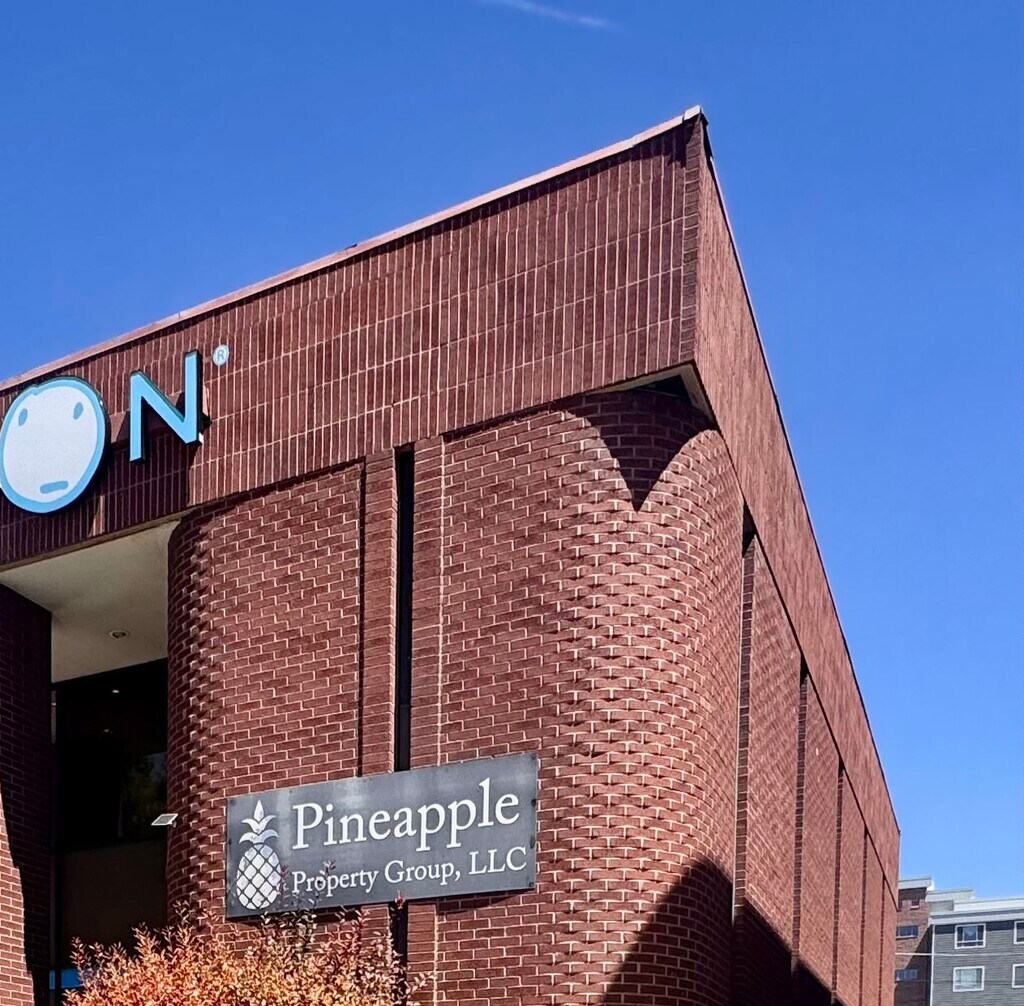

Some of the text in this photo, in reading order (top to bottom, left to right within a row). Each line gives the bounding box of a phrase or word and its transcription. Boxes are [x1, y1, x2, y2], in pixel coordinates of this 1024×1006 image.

[292, 777, 521, 852] Pineapple
[291, 846, 527, 897] Property Group, LLC
